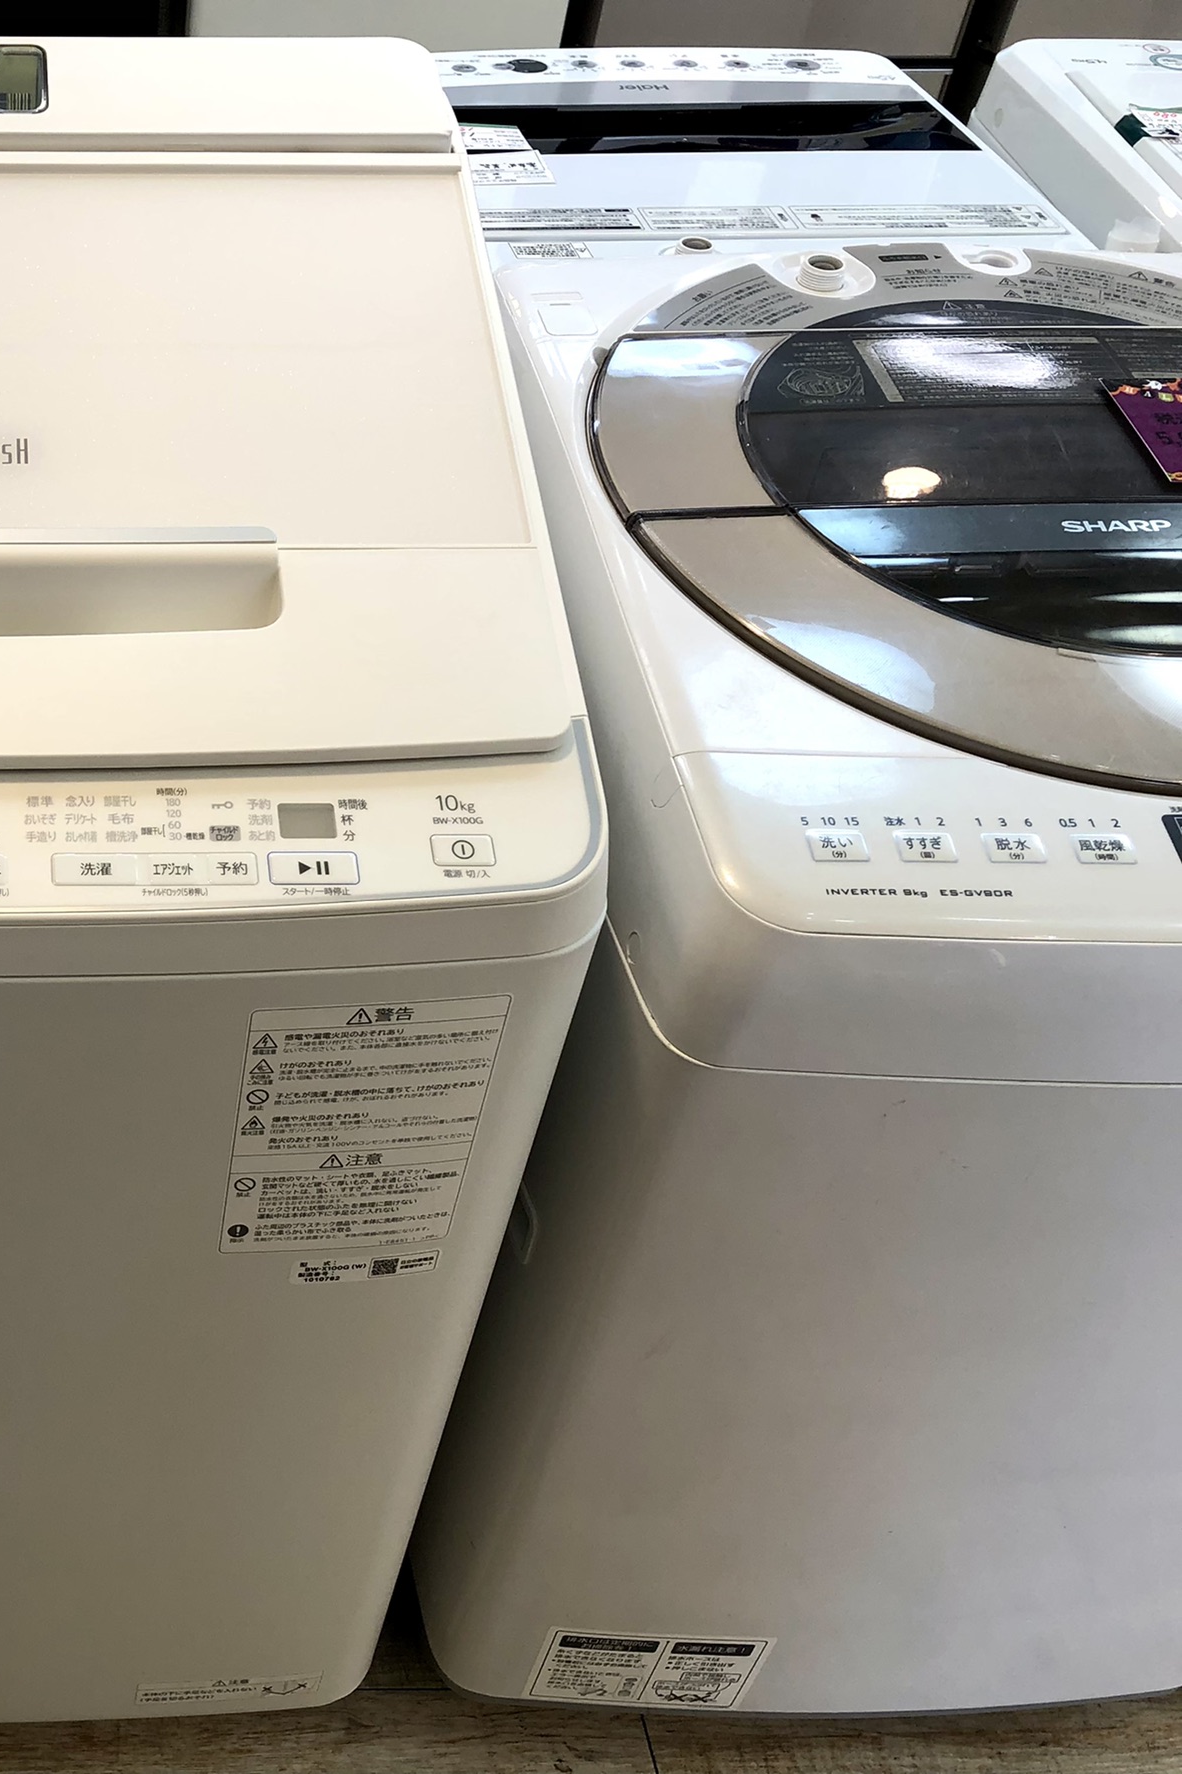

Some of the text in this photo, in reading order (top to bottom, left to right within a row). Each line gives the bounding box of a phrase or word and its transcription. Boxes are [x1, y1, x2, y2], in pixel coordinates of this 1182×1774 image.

[1061, 519, 1171, 532] SHARP
[156, 788, 188, 796] 時間(分)
[26, 795, 54, 807] 標準
[65, 795, 95, 807] 念入り
[103, 795, 136, 807] 部屋干し
[165, 798, 181, 807] 180
[246, 799, 271, 810] 予約
[337, 799, 368, 811] 時間後
[435, 794, 476, 814] 10kg
[24, 813, 57, 825] おいそぎ
[65, 813, 97, 825] デリケート
[108, 813, 135, 825] 毛布
[166, 809, 182, 818] 120
[168, 821, 181, 829] 60
[248, 814, 273, 826] 洗剤
[341, 814, 354, 825] 杯
[800, 817, 860, 826] 5 10 15
[884, 817, 945, 827] 注水 1 2
[975, 818, 1033, 828] 1 3 6
[1059, 818, 1121, 828] 0.5 1 2
[209, 826, 239, 834] チャイルド
[25, 831, 57, 843] 手造り
[105, 831, 138, 842] 槽洗浄
[169, 832, 182, 841] 30
[248, 830, 276, 842] あと約
[342, 831, 355, 842] 分
[820, 837, 854, 849] 洗い
[903, 837, 941, 851] すすぎ
[996, 837, 1031, 851] 脱水
[1079, 839, 1126, 852] 風乾燥
[831, 850, 847, 859] (分)
[1008, 852, 1025, 860] (分)
[79, 862, 113, 877] 洗濯
[153, 863, 194, 876] エアジェット
[215, 861, 248, 876] 予約
[465, 869, 491, 878] 切/入
[282, 887, 351, 896] スタート/一時停止
[825, 888, 898, 896] INVERTER
[374, 1006, 415, 1022] 警告
[279, 1059, 353, 1069] けがのおそれあり
[268, 1135, 339, 1145] 発火のおそれあり
[345, 1153, 384, 1167] 注意
